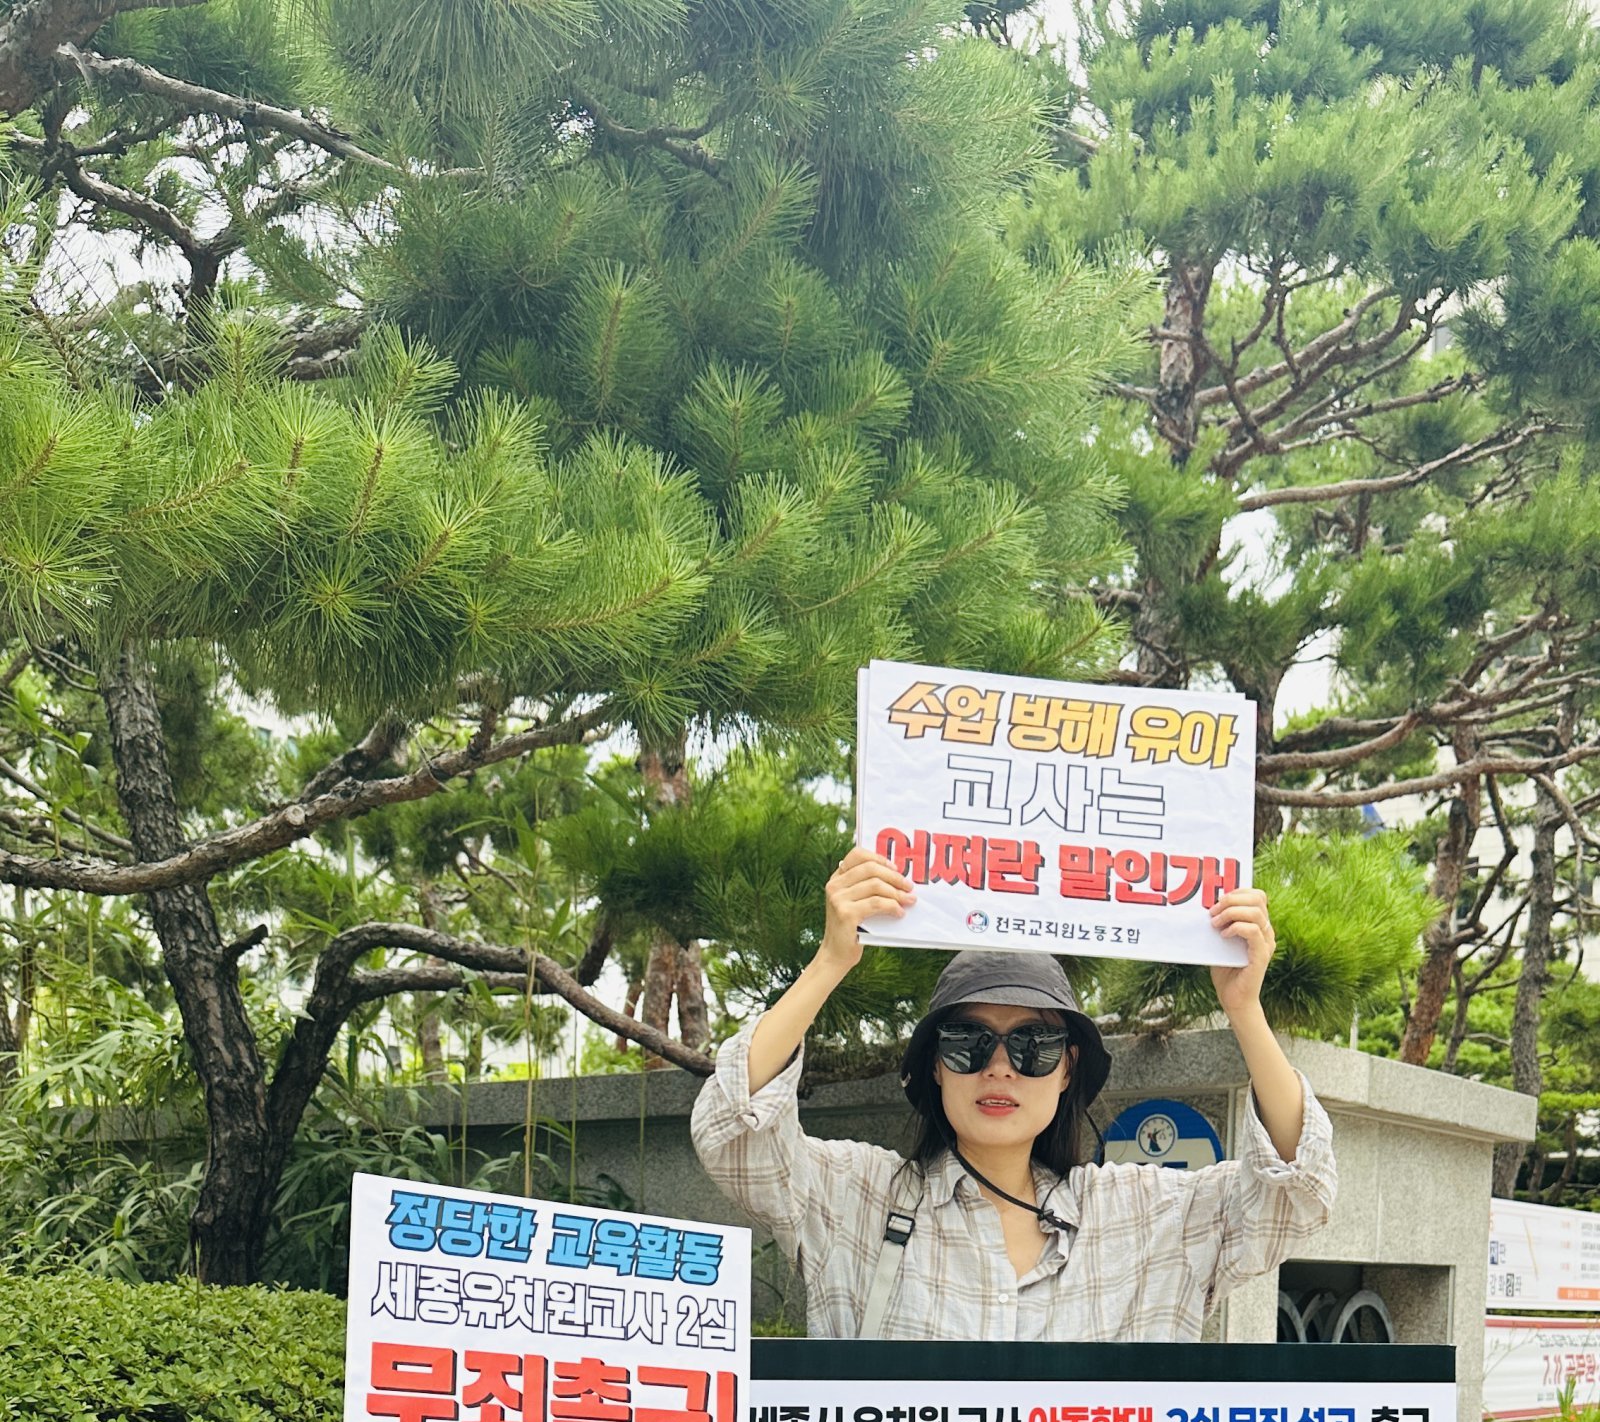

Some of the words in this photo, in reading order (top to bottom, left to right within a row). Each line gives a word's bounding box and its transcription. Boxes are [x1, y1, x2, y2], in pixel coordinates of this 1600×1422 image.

[888, 681, 1004, 746] 수업
[1008, 692, 1124, 759] 방해
[1126, 706, 1239, 769] 유아
[942, 753, 1165, 840] 교사는
[875, 827, 1046, 896] 어쩌란
[996, 916, 1141, 944] 전국교직원노동조합
[386, 1190, 539, 1263] 정당한
[546, 1213, 724, 1286] 교육활동
[370, 1261, 668, 1345] 세종유치원교사
[675, 1295, 737, 1352] 2심
